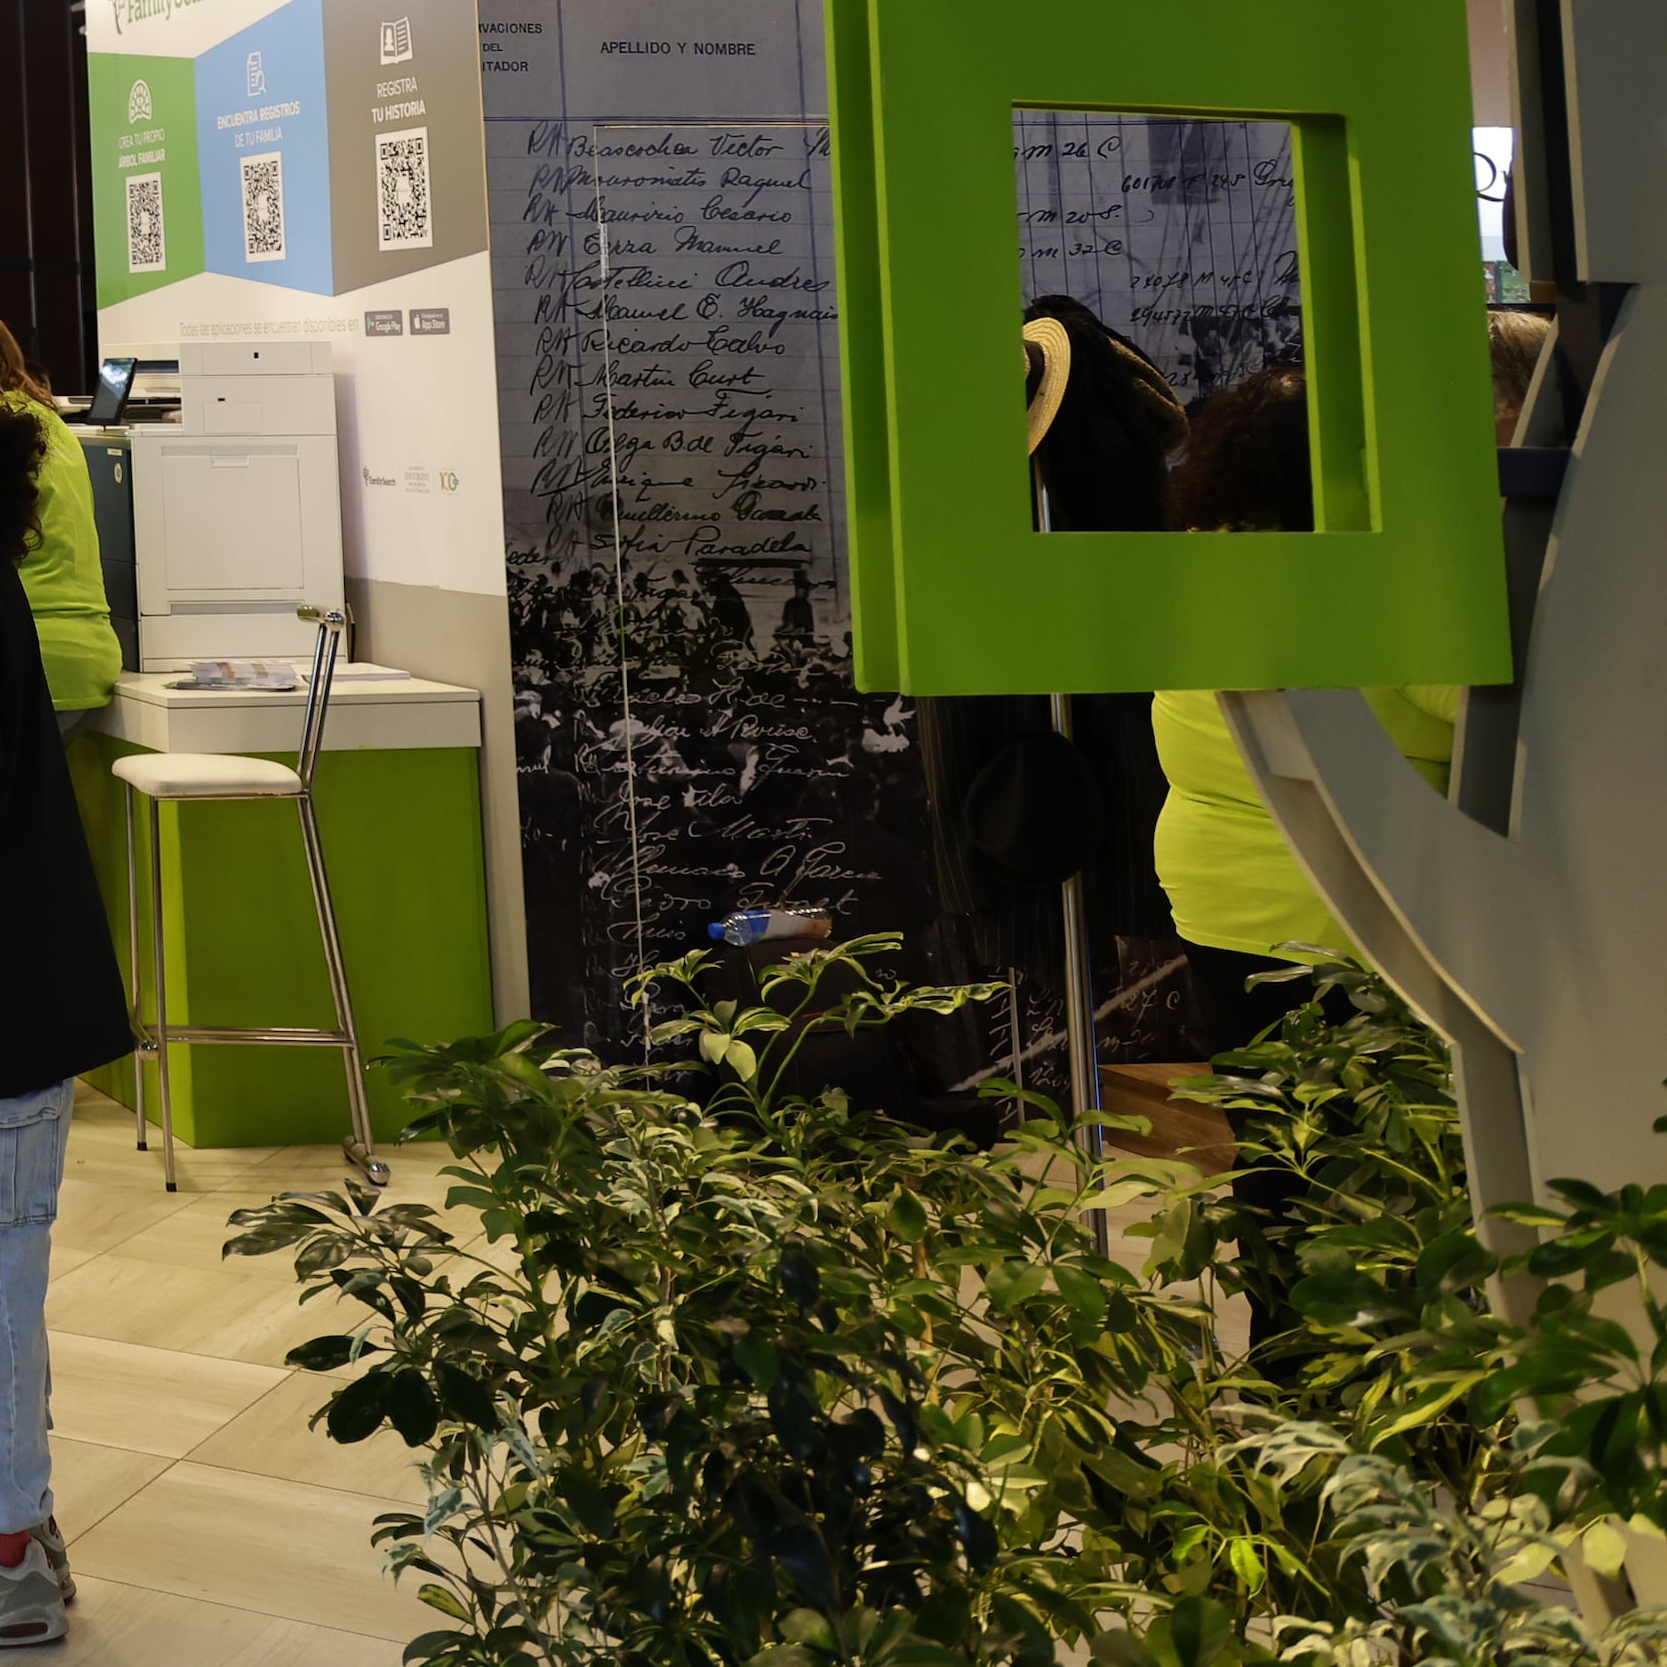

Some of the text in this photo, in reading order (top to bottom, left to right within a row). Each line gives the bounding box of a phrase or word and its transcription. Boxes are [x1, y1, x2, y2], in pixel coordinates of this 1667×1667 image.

[482, 43, 504, 52] DEL
[600, 42, 756, 56] APELLIDO Y NOMBRE
[377, 76, 418, 98] REGISTRA
[217, 101, 301, 130] ENCUENTRA REGISTROS
[371, 100, 426, 123] TU HISTORIA
[303, 317, 346, 333] disponibles
[348, 319, 359, 332] en
